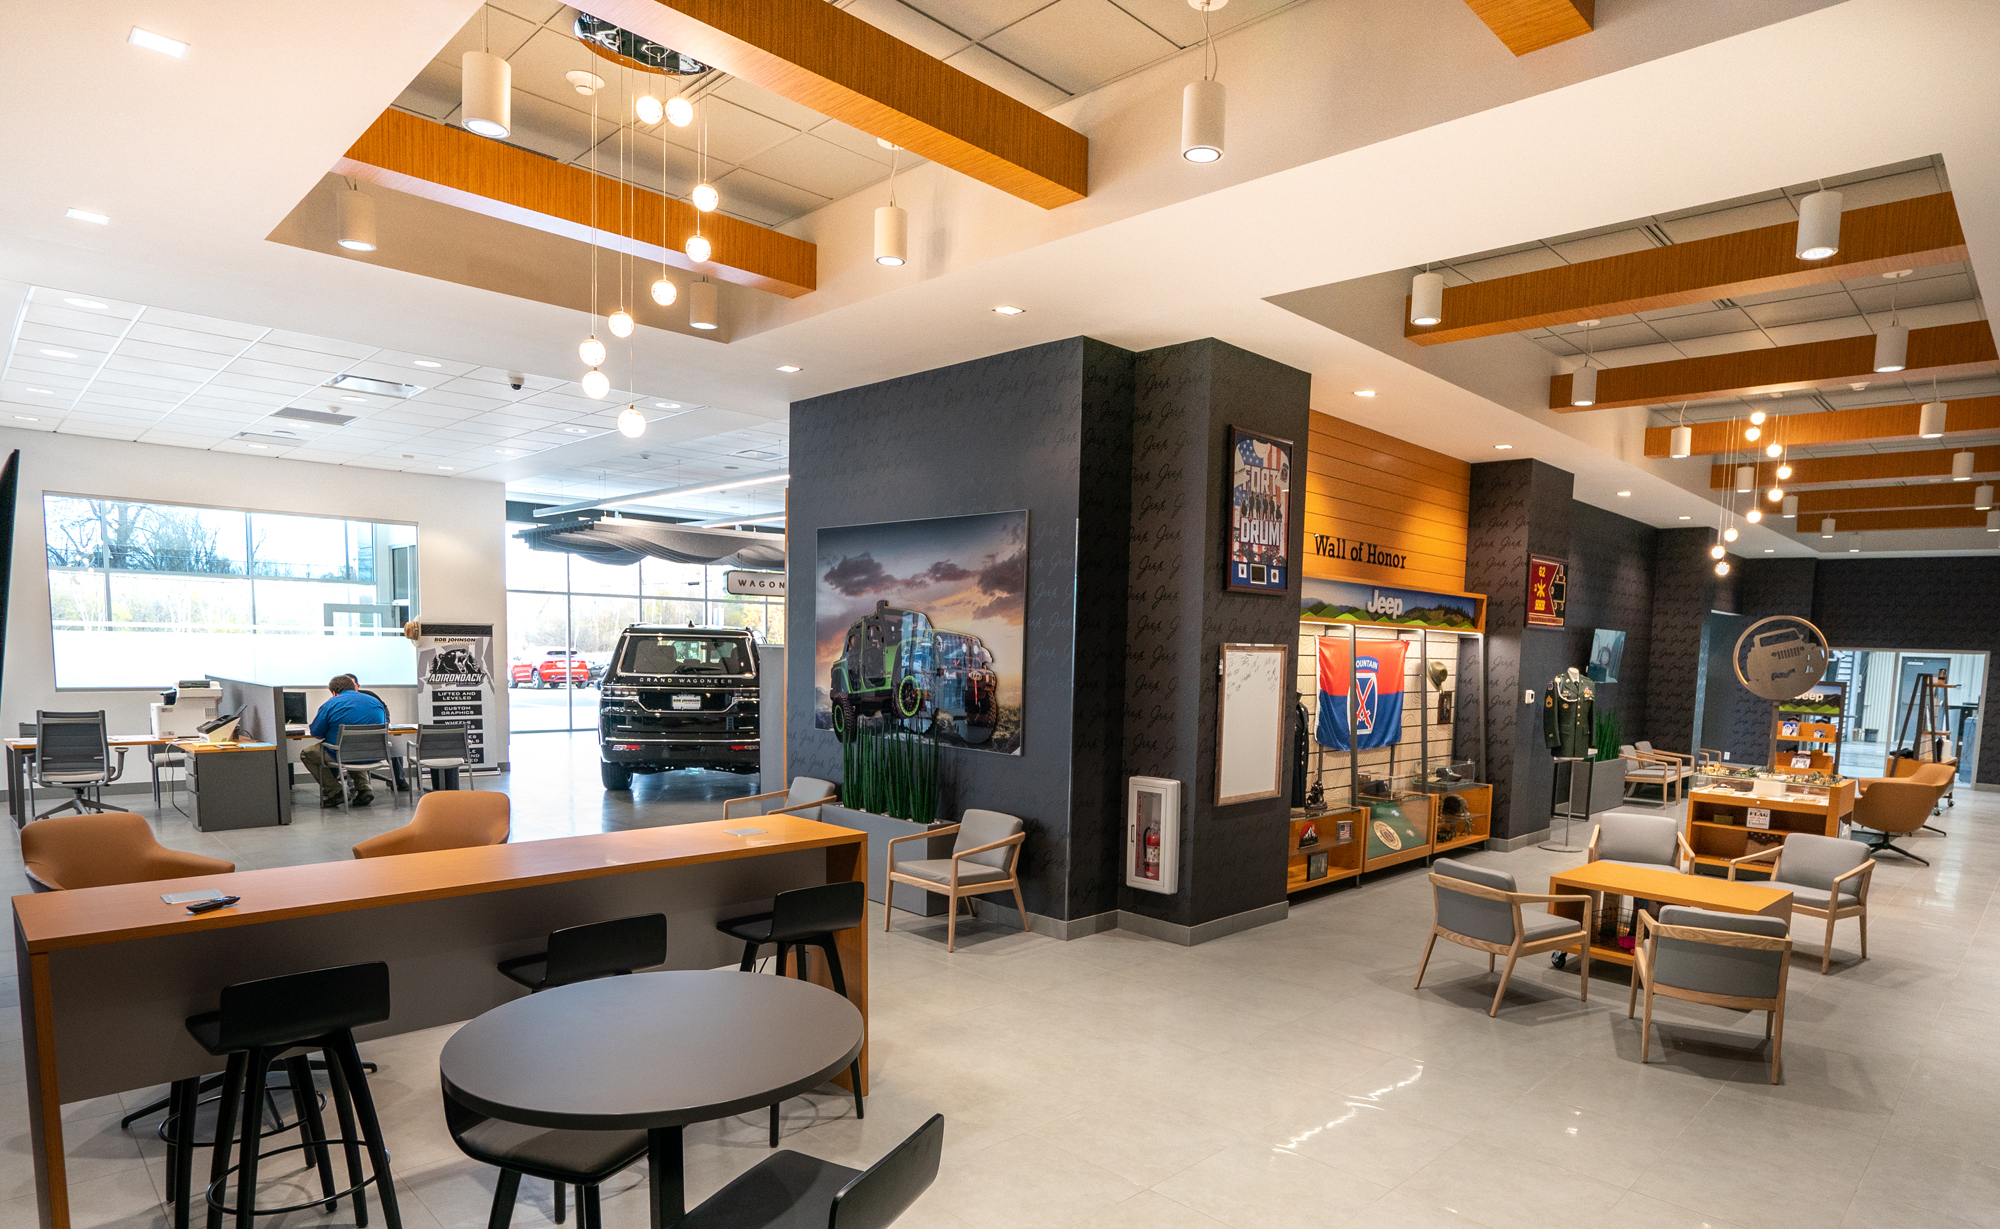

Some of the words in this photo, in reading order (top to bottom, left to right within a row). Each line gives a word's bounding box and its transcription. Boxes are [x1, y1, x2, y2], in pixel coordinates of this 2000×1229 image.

[1242, 465, 1279, 496] FORT
[1240, 518, 1280, 546] DRUM
[1314, 533, 1346, 559] Wall
[1350, 542, 1363, 562] of
[1367, 543, 1407, 569] Honor
[1538, 565, 1546, 578] 62
[737, 579, 785, 589] WAGON
[1367, 589, 1403, 619] Jeep
[1356, 659, 1379, 670] OUNTAIN
[429, 673, 483, 682] ADIRONDACK
